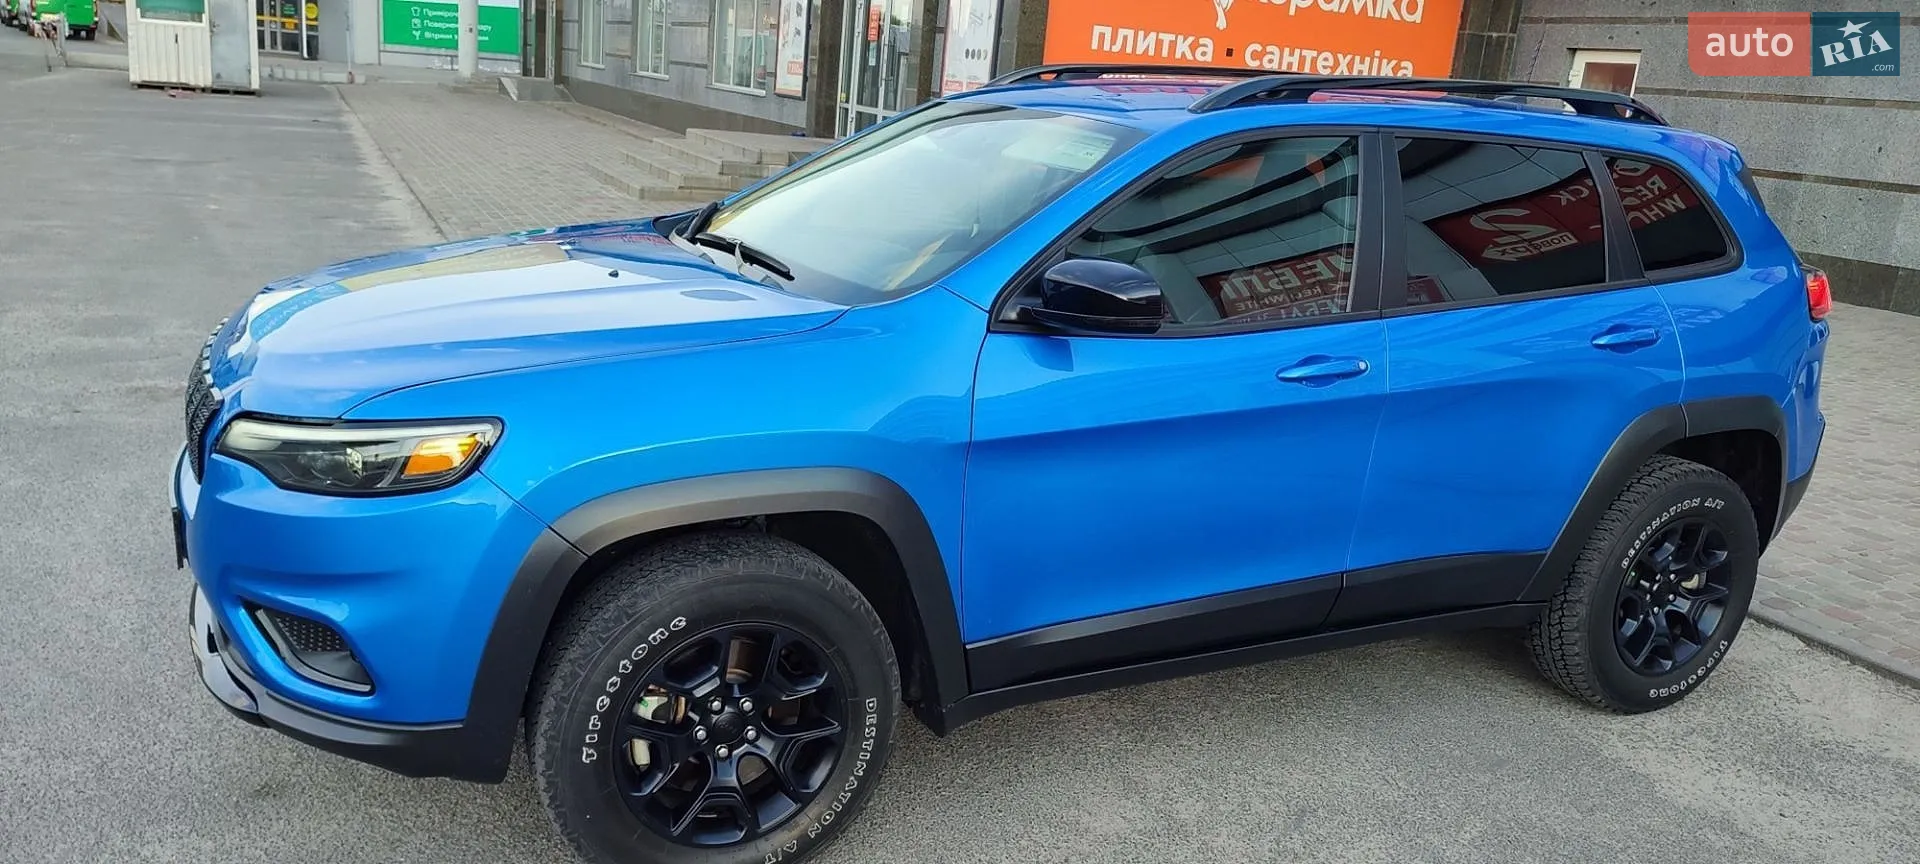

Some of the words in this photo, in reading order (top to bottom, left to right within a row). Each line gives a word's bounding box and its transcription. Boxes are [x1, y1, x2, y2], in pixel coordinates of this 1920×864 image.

[1090, 24, 1214, 63] плитка
[1244, 42, 1415, 79] сантехніка
[1621, 497, 1701, 569] DESTINATION
[807, 697, 877, 839] DESTINATION
